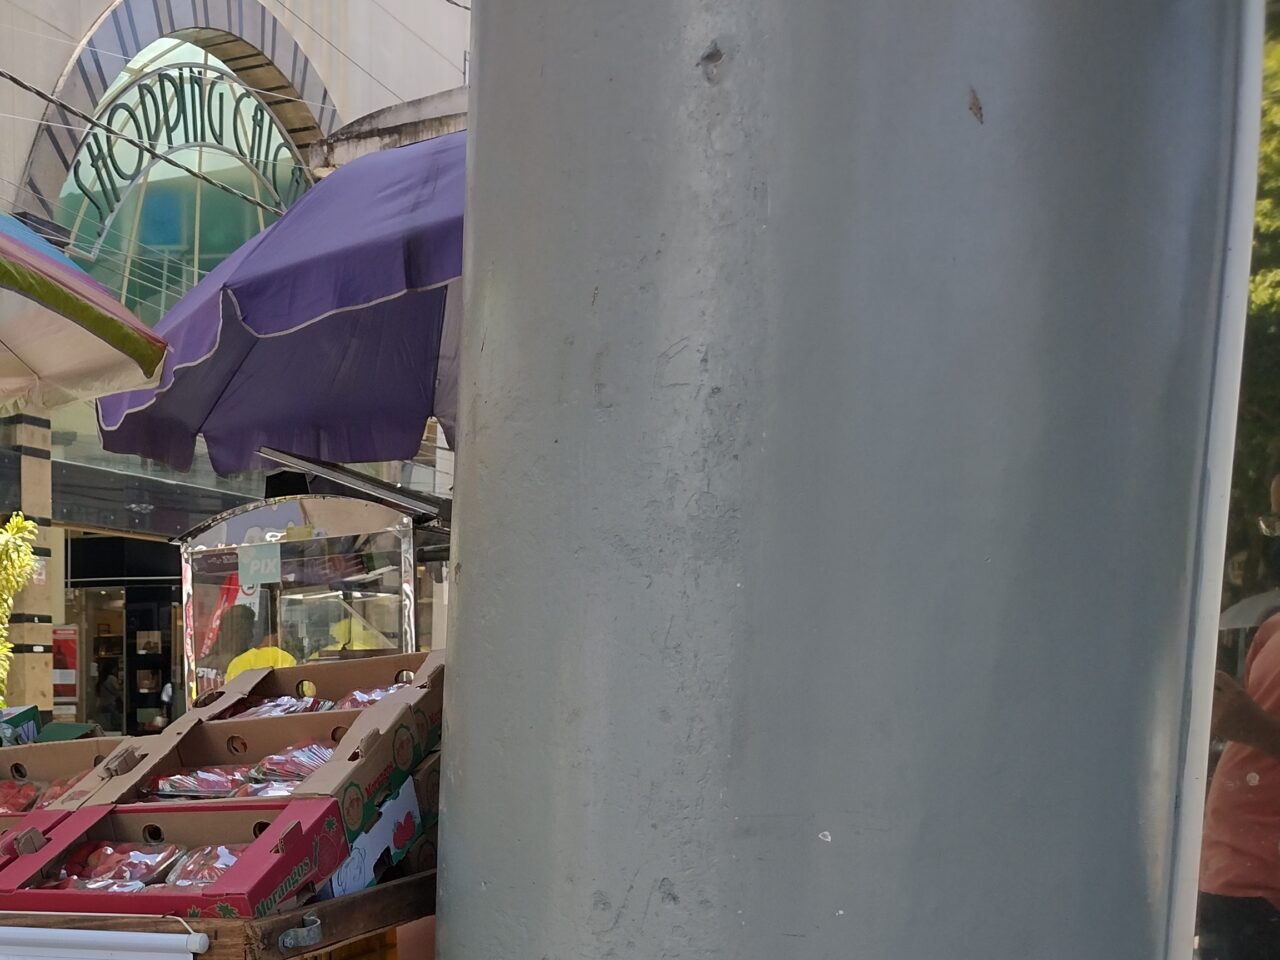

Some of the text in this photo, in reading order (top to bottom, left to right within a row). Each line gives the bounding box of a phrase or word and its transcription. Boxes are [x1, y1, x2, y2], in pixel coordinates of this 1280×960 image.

[74, 67, 225, 237] SHOPPING
[249, 558, 277, 575] PIX
[256, 856, 310, 918] Morangos
